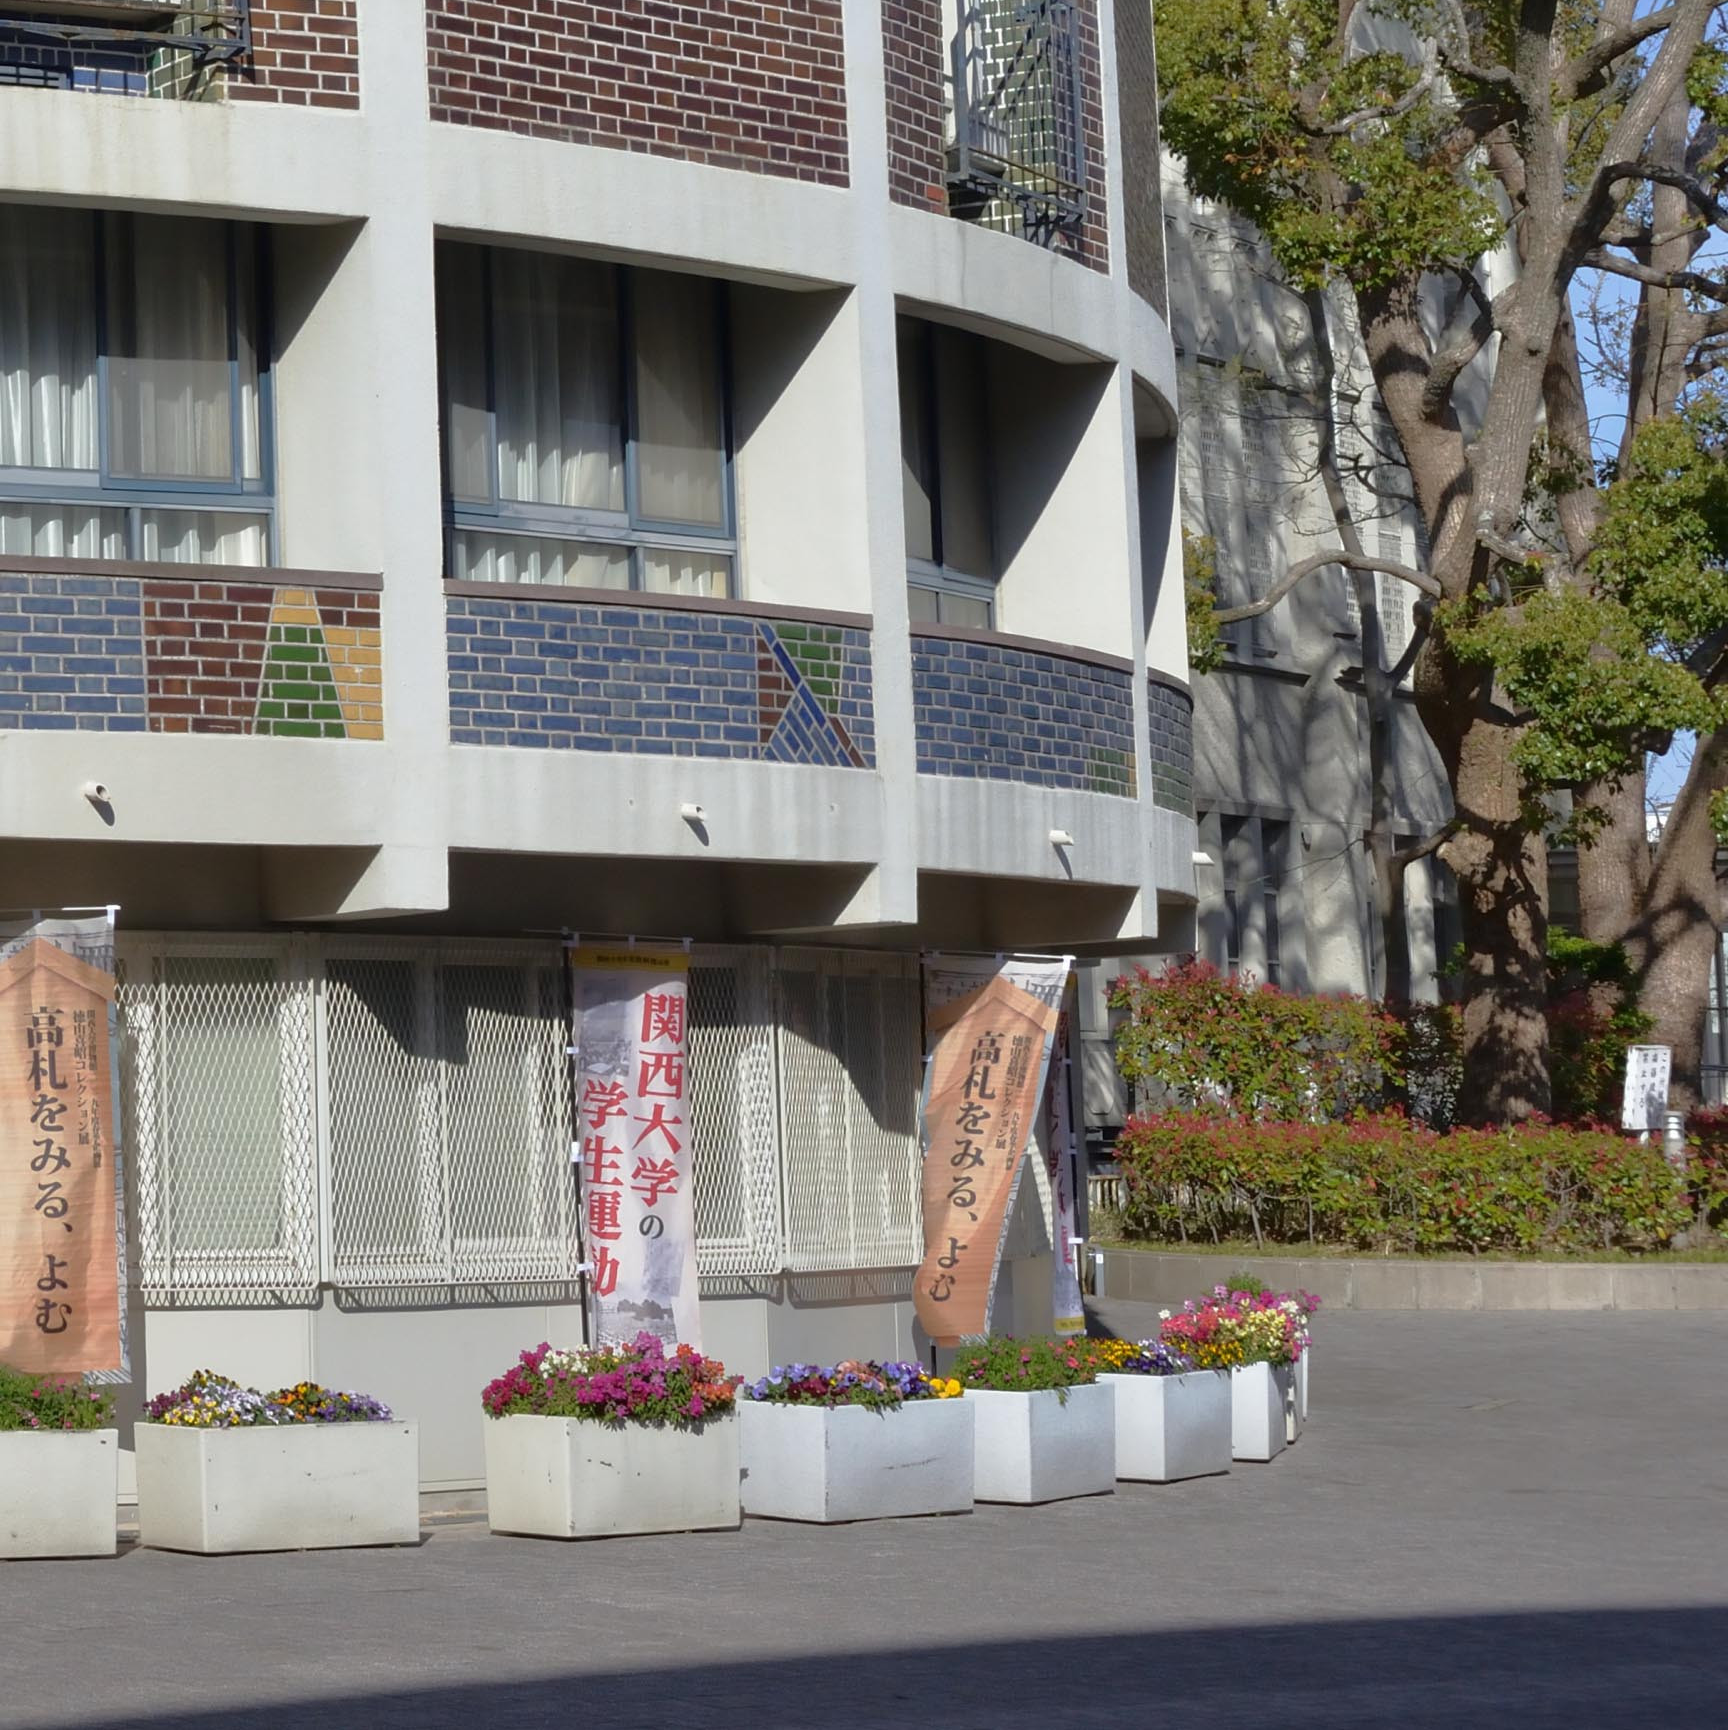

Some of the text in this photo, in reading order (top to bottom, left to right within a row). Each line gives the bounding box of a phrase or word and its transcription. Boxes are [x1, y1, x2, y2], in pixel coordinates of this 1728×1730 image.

[630, 993, 685, 1240] 関西大学の
